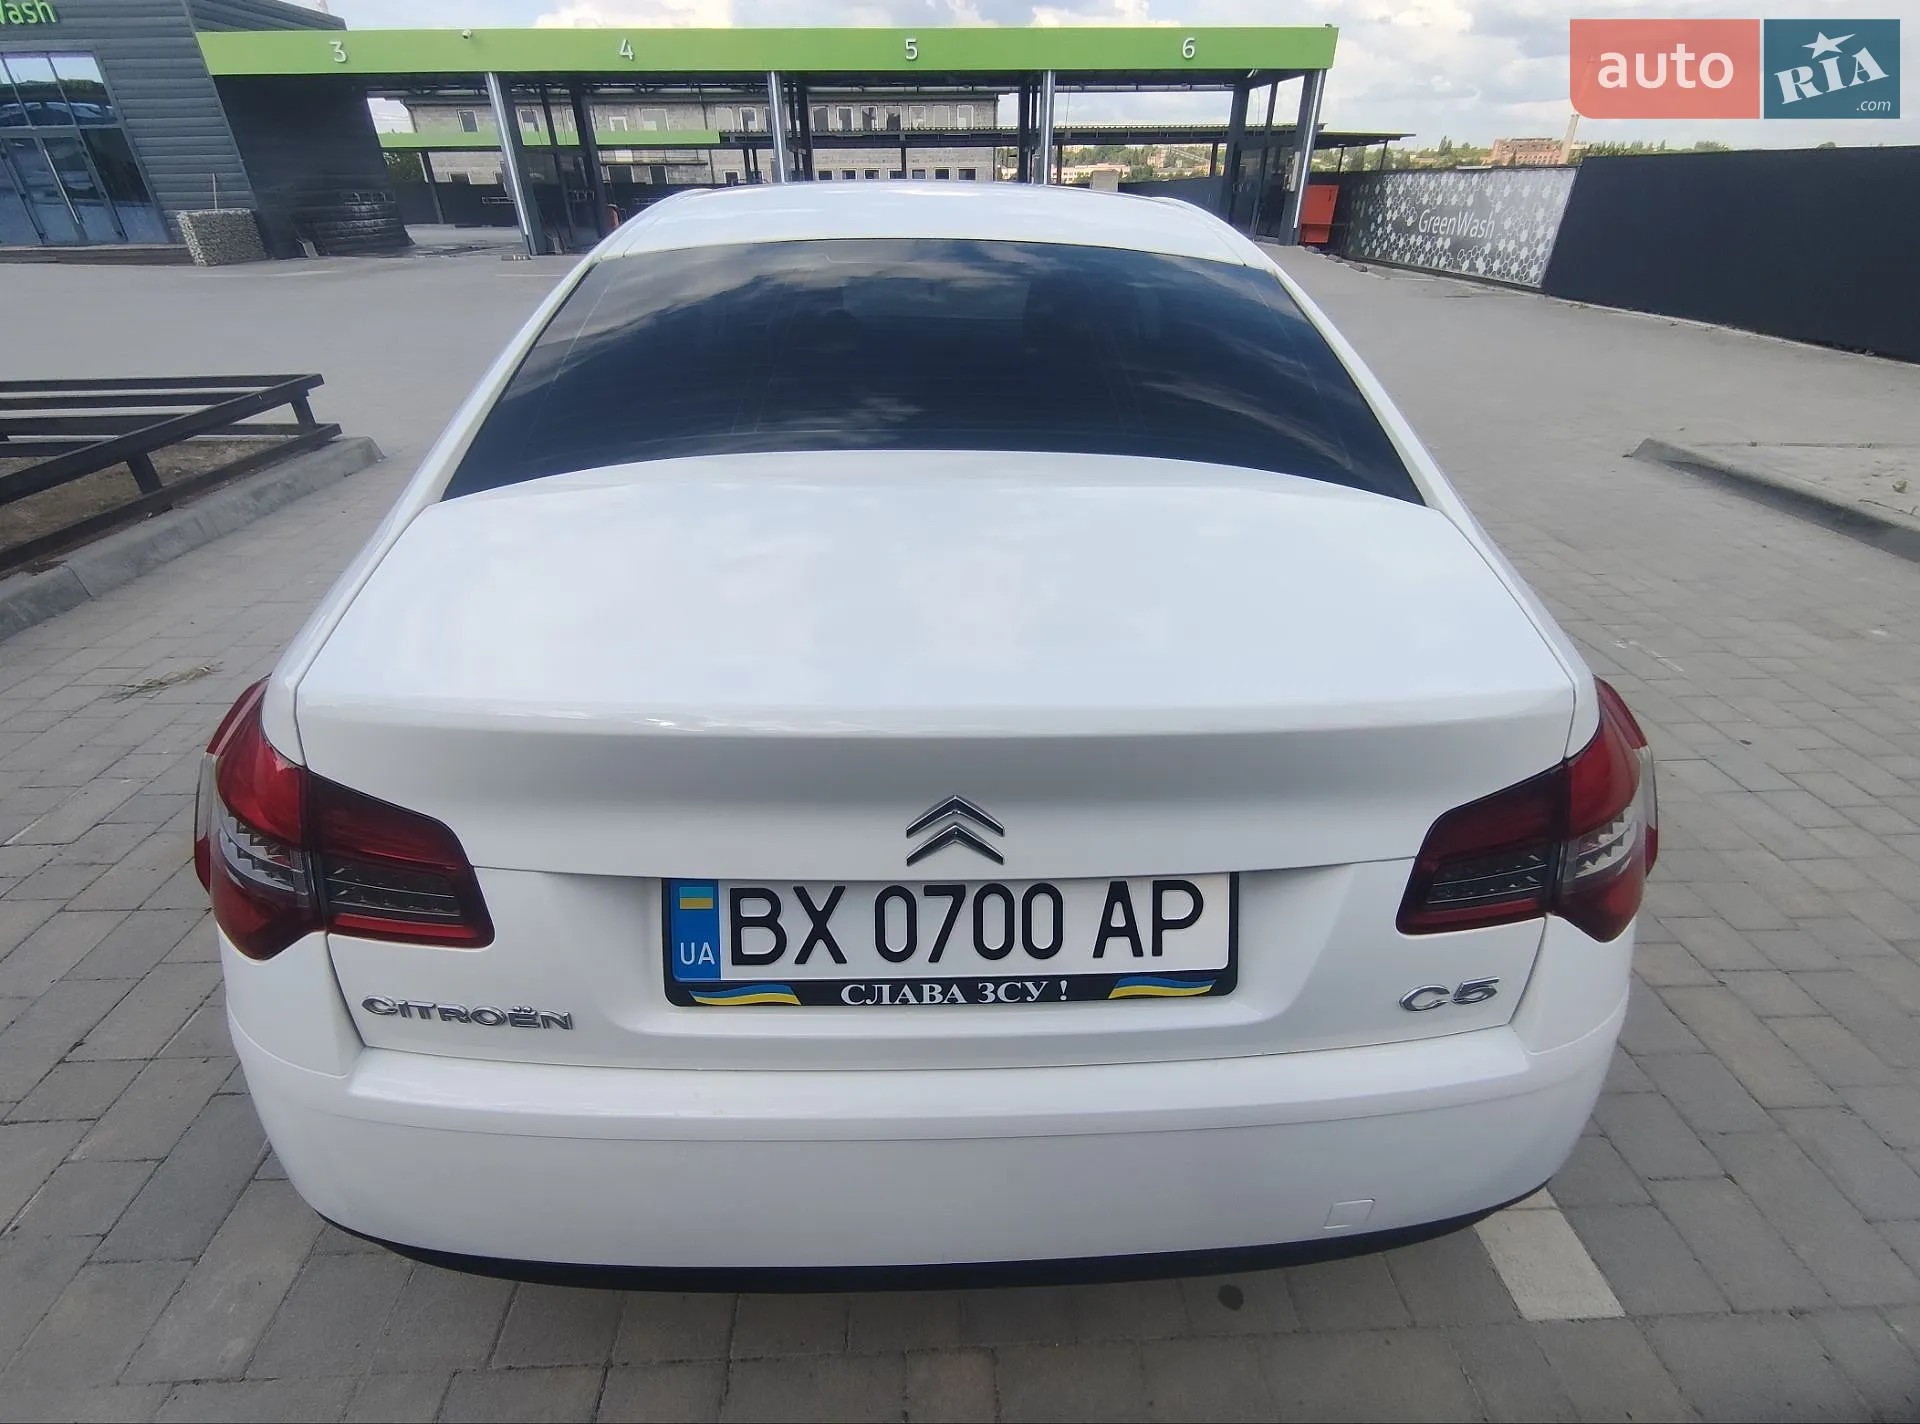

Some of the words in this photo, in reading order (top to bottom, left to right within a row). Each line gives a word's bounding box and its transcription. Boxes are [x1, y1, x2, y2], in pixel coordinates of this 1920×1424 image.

[329, 41, 347, 63] 3
[619, 39, 633, 61] 4
[905, 39, 918, 61] 5
[1181, 37, 1196, 60] 6
[1418, 208, 1495, 239] GreenWash
[729, 884, 848, 967] BX
[873, 882, 1064, 963] 0700
[1092, 878, 1204, 958] AP
[679, 941, 716, 966] UA
[839, 982, 966, 1006] СЛАВА
[976, 980, 1050, 1003] ЗСУ
[1399, 976, 1499, 1012] C5
[361, 995, 574, 1031] CITROËN
